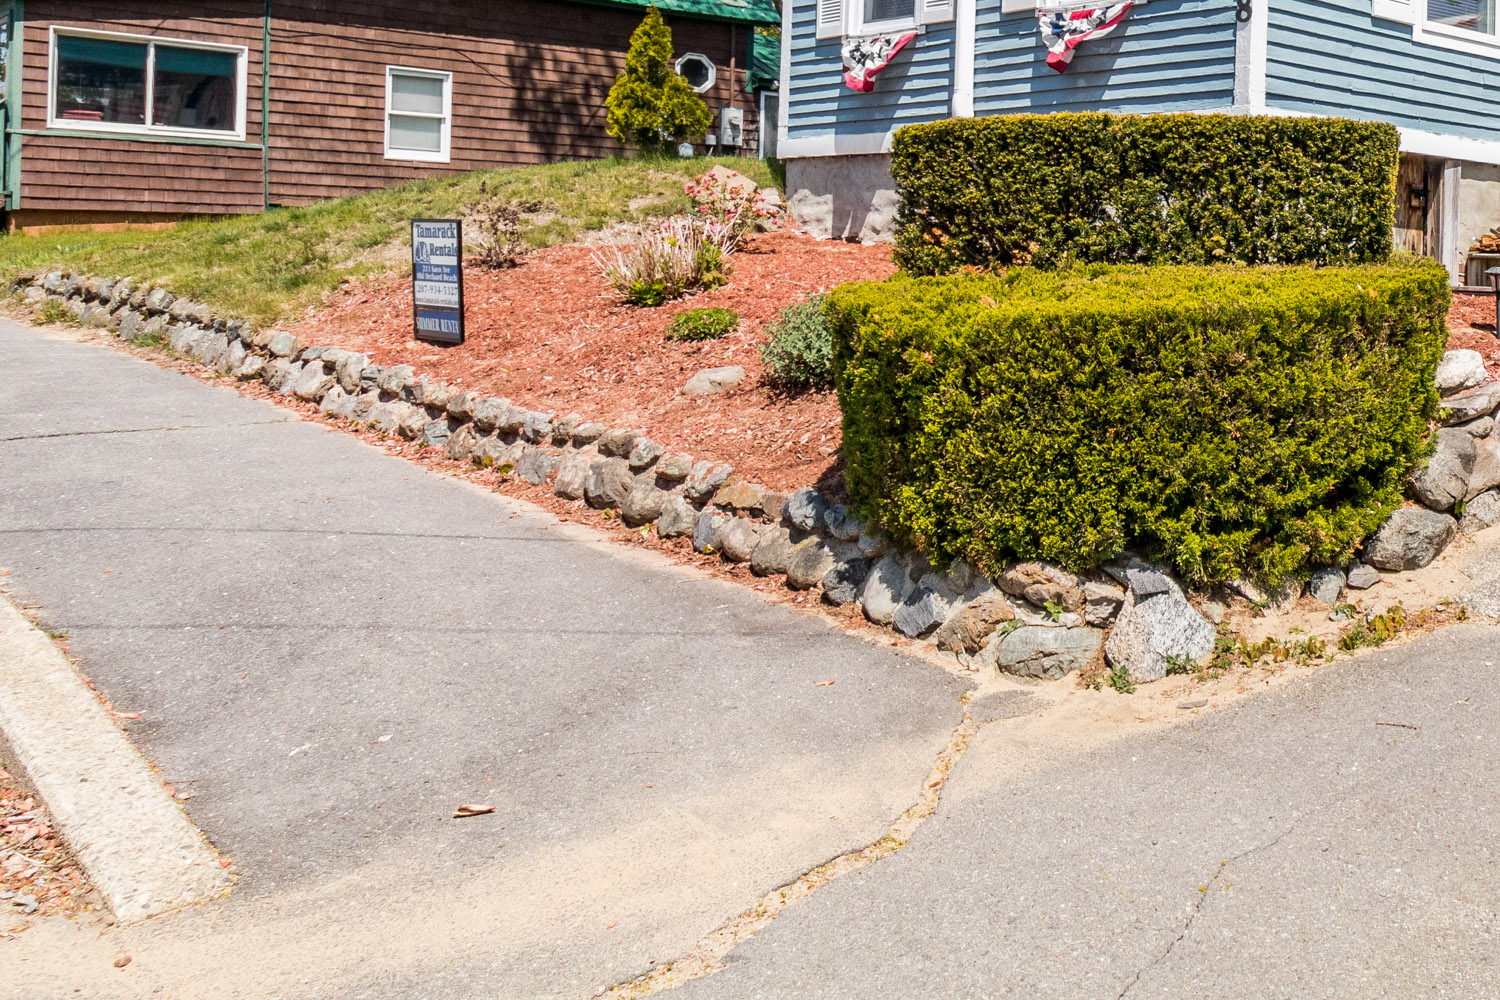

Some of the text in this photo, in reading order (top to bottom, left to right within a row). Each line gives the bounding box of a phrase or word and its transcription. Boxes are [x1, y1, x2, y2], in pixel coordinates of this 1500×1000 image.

[415, 223, 456, 238] Tamarack
[443, 274, 457, 282] Beach
[417, 284, 458, 296] 207-934-5327
[416, 316, 441, 332] SUMMER
